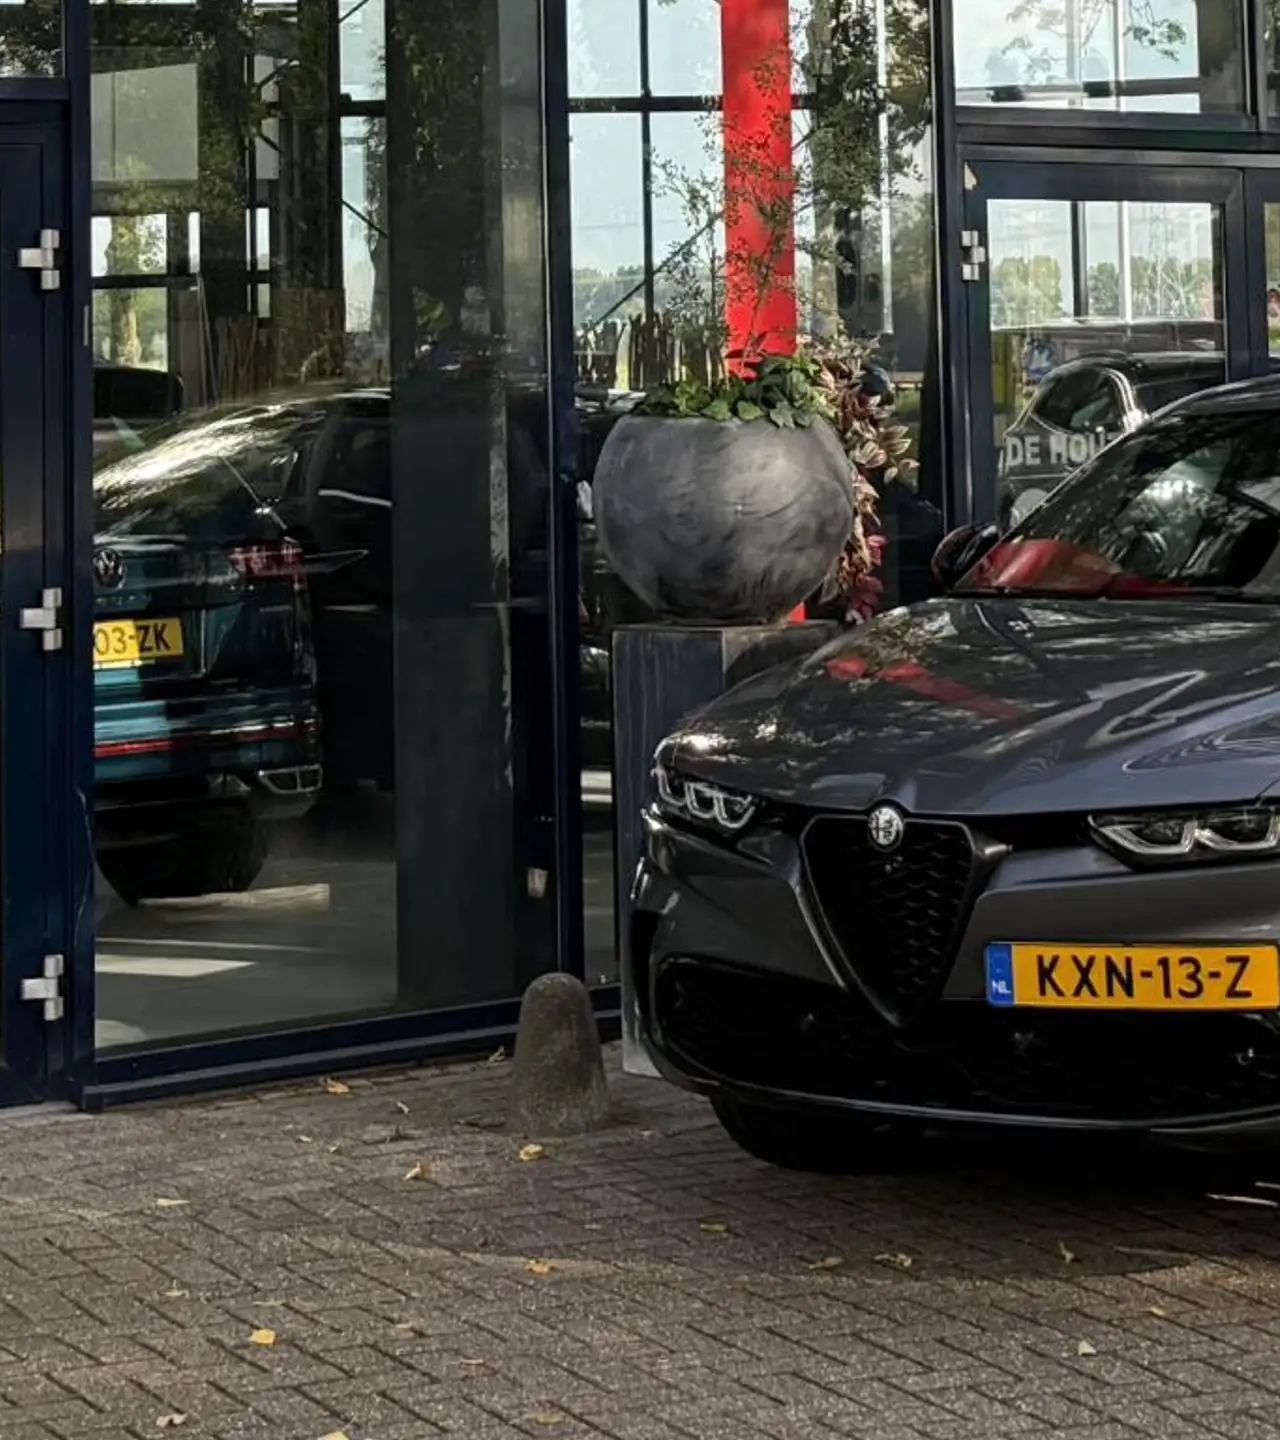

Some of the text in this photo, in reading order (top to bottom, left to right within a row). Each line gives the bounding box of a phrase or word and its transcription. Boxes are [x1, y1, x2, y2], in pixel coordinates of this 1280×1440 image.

[1005, 435, 1041, 467] DE
[990, 980, 1012, 994] NL
[1036, 954, 1252, 999] KXN-13-Z
